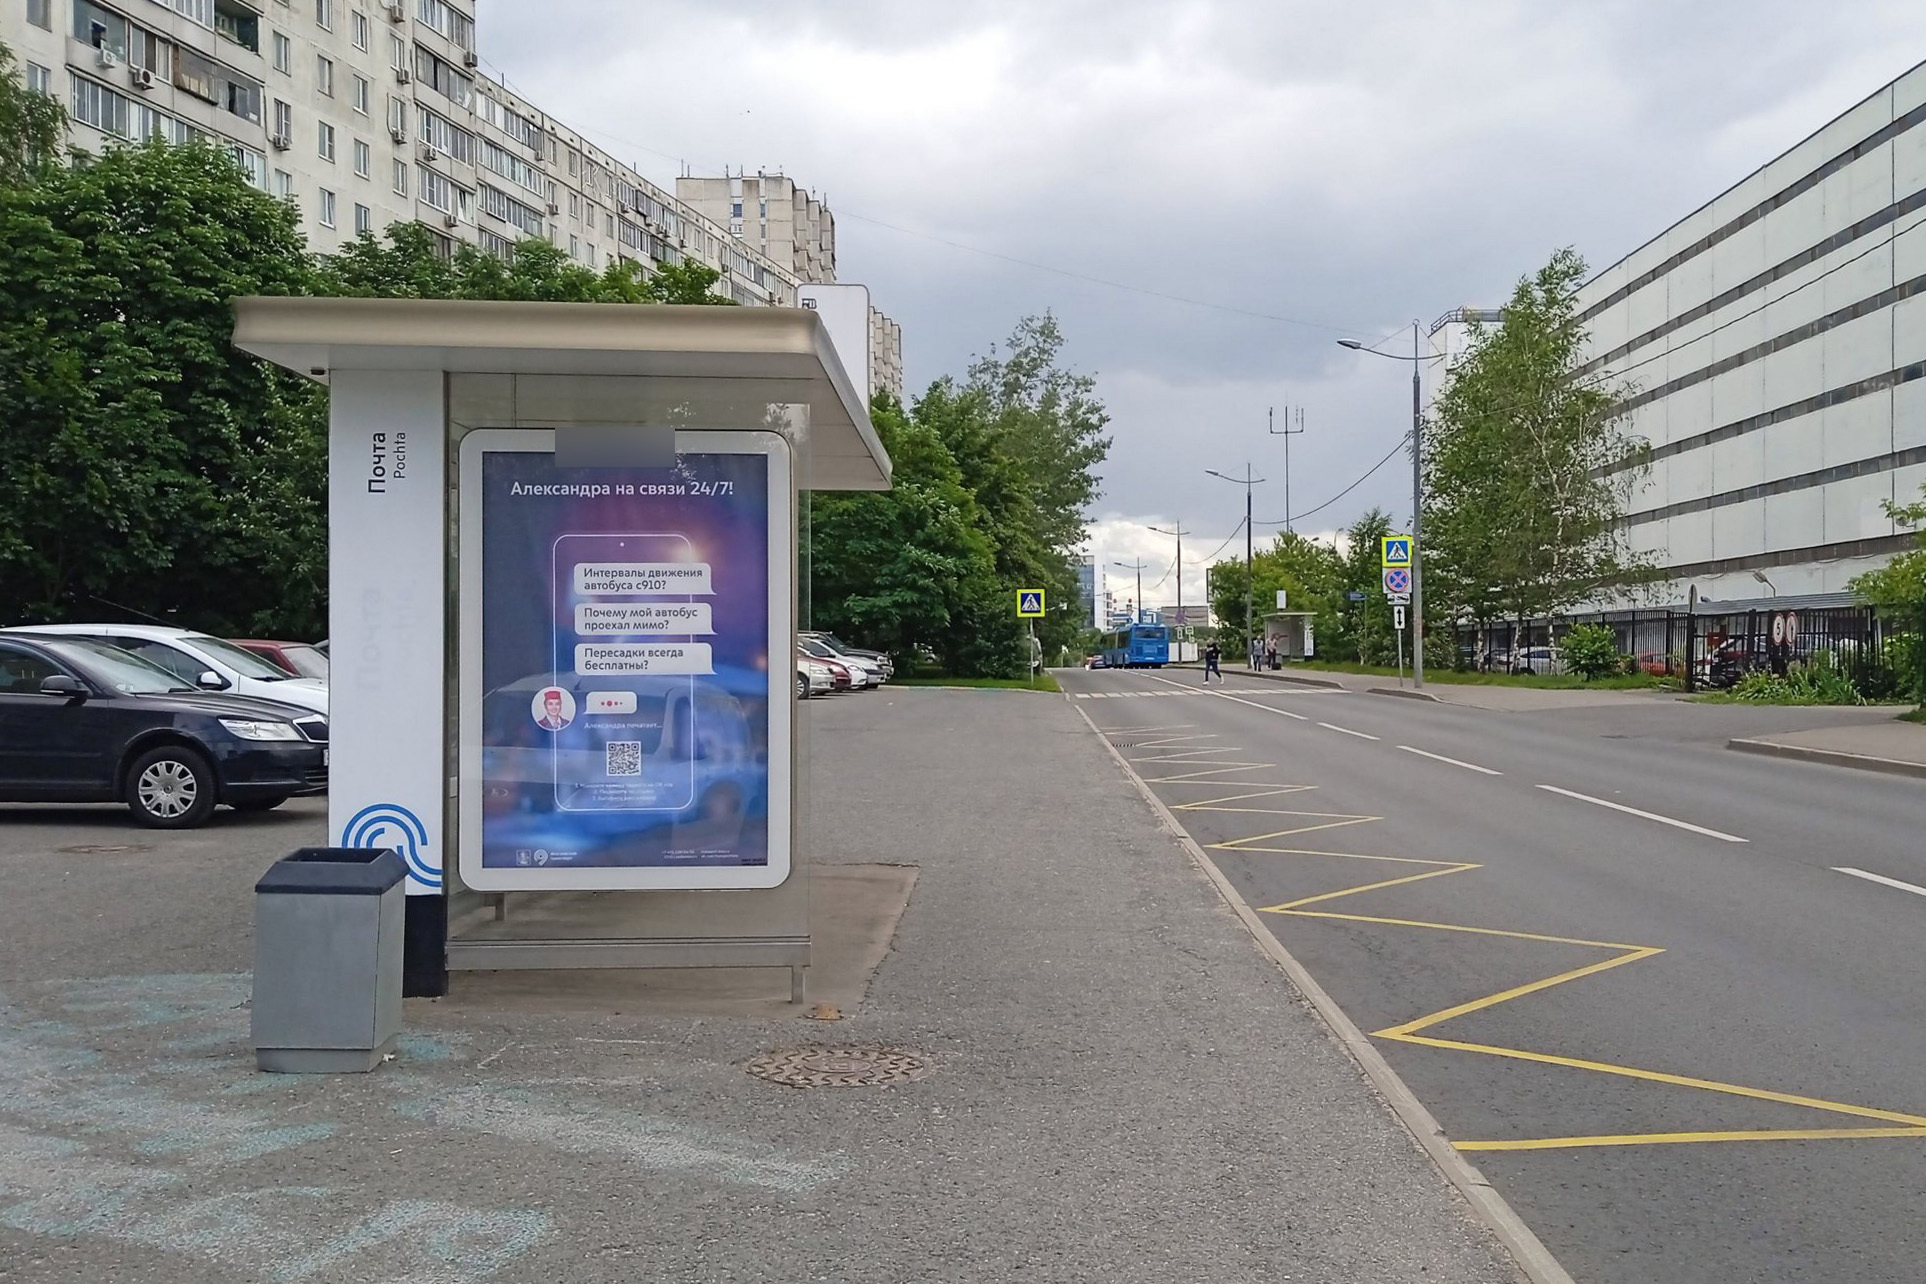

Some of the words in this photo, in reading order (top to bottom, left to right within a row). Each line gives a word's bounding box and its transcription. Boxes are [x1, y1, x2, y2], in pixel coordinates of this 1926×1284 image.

[393, 432, 406, 479] Pochta
[368, 432, 386, 493] Почта
[510, 481, 611, 498] Александра
[616, 484, 635, 496] на
[639, 484, 686, 496] связи
[690, 481, 734, 497] 24/7!
[583, 568, 646, 579] Интервалы
[648, 569, 703, 579] движения
[584, 580, 633, 592] автобуса
[584, 607, 628, 619] Почему
[629, 607, 653, 618] мой
[655, 607, 698, 619] автобус
[584, 621, 630, 631] проехал
[632, 620, 670, 630] мимо?
[584, 647, 646, 659] Пересадки
[648, 649, 684, 659] всегда
[584, 660, 649, 671] бесплатны?
